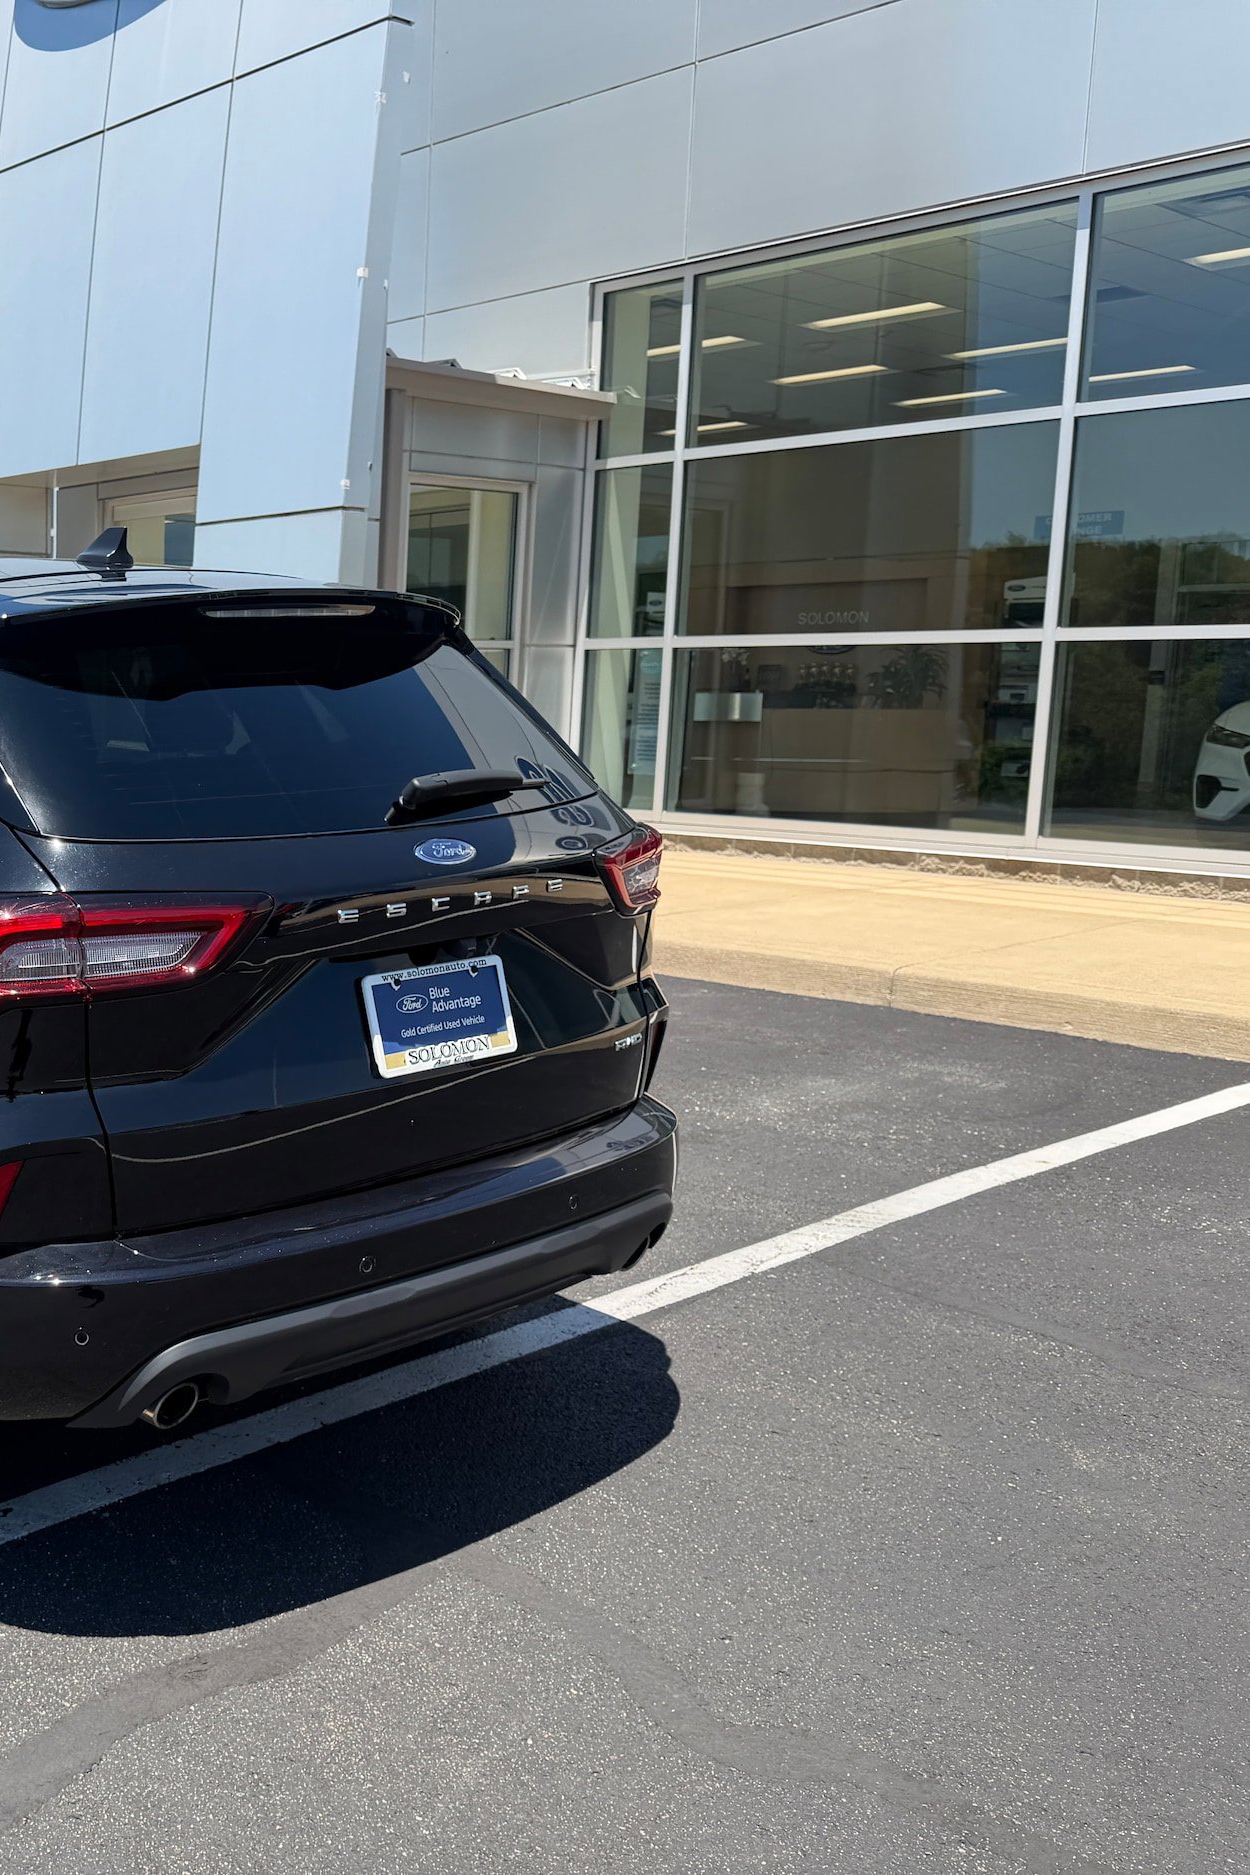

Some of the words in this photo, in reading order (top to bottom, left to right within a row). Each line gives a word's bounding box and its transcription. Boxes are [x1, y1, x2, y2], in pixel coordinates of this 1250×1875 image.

[797, 610, 870, 625] SOLOMON
[432, 842, 465, 857] Ford
[337, 879, 564, 924] ESCAPE
[381, 958, 487, 983] www.solomonauto.com
[429, 986, 450, 1000] Blue
[402, 997, 423, 1011] Ford
[432, 995, 482, 1013] Advantage
[400, 1027, 417, 1039] Gold
[416, 1022, 443, 1036] Certified
[444, 1019, 461, 1030] Used
[461, 1014, 485, 1027] Vehicle
[408, 1035, 491, 1065] SOLOMON
